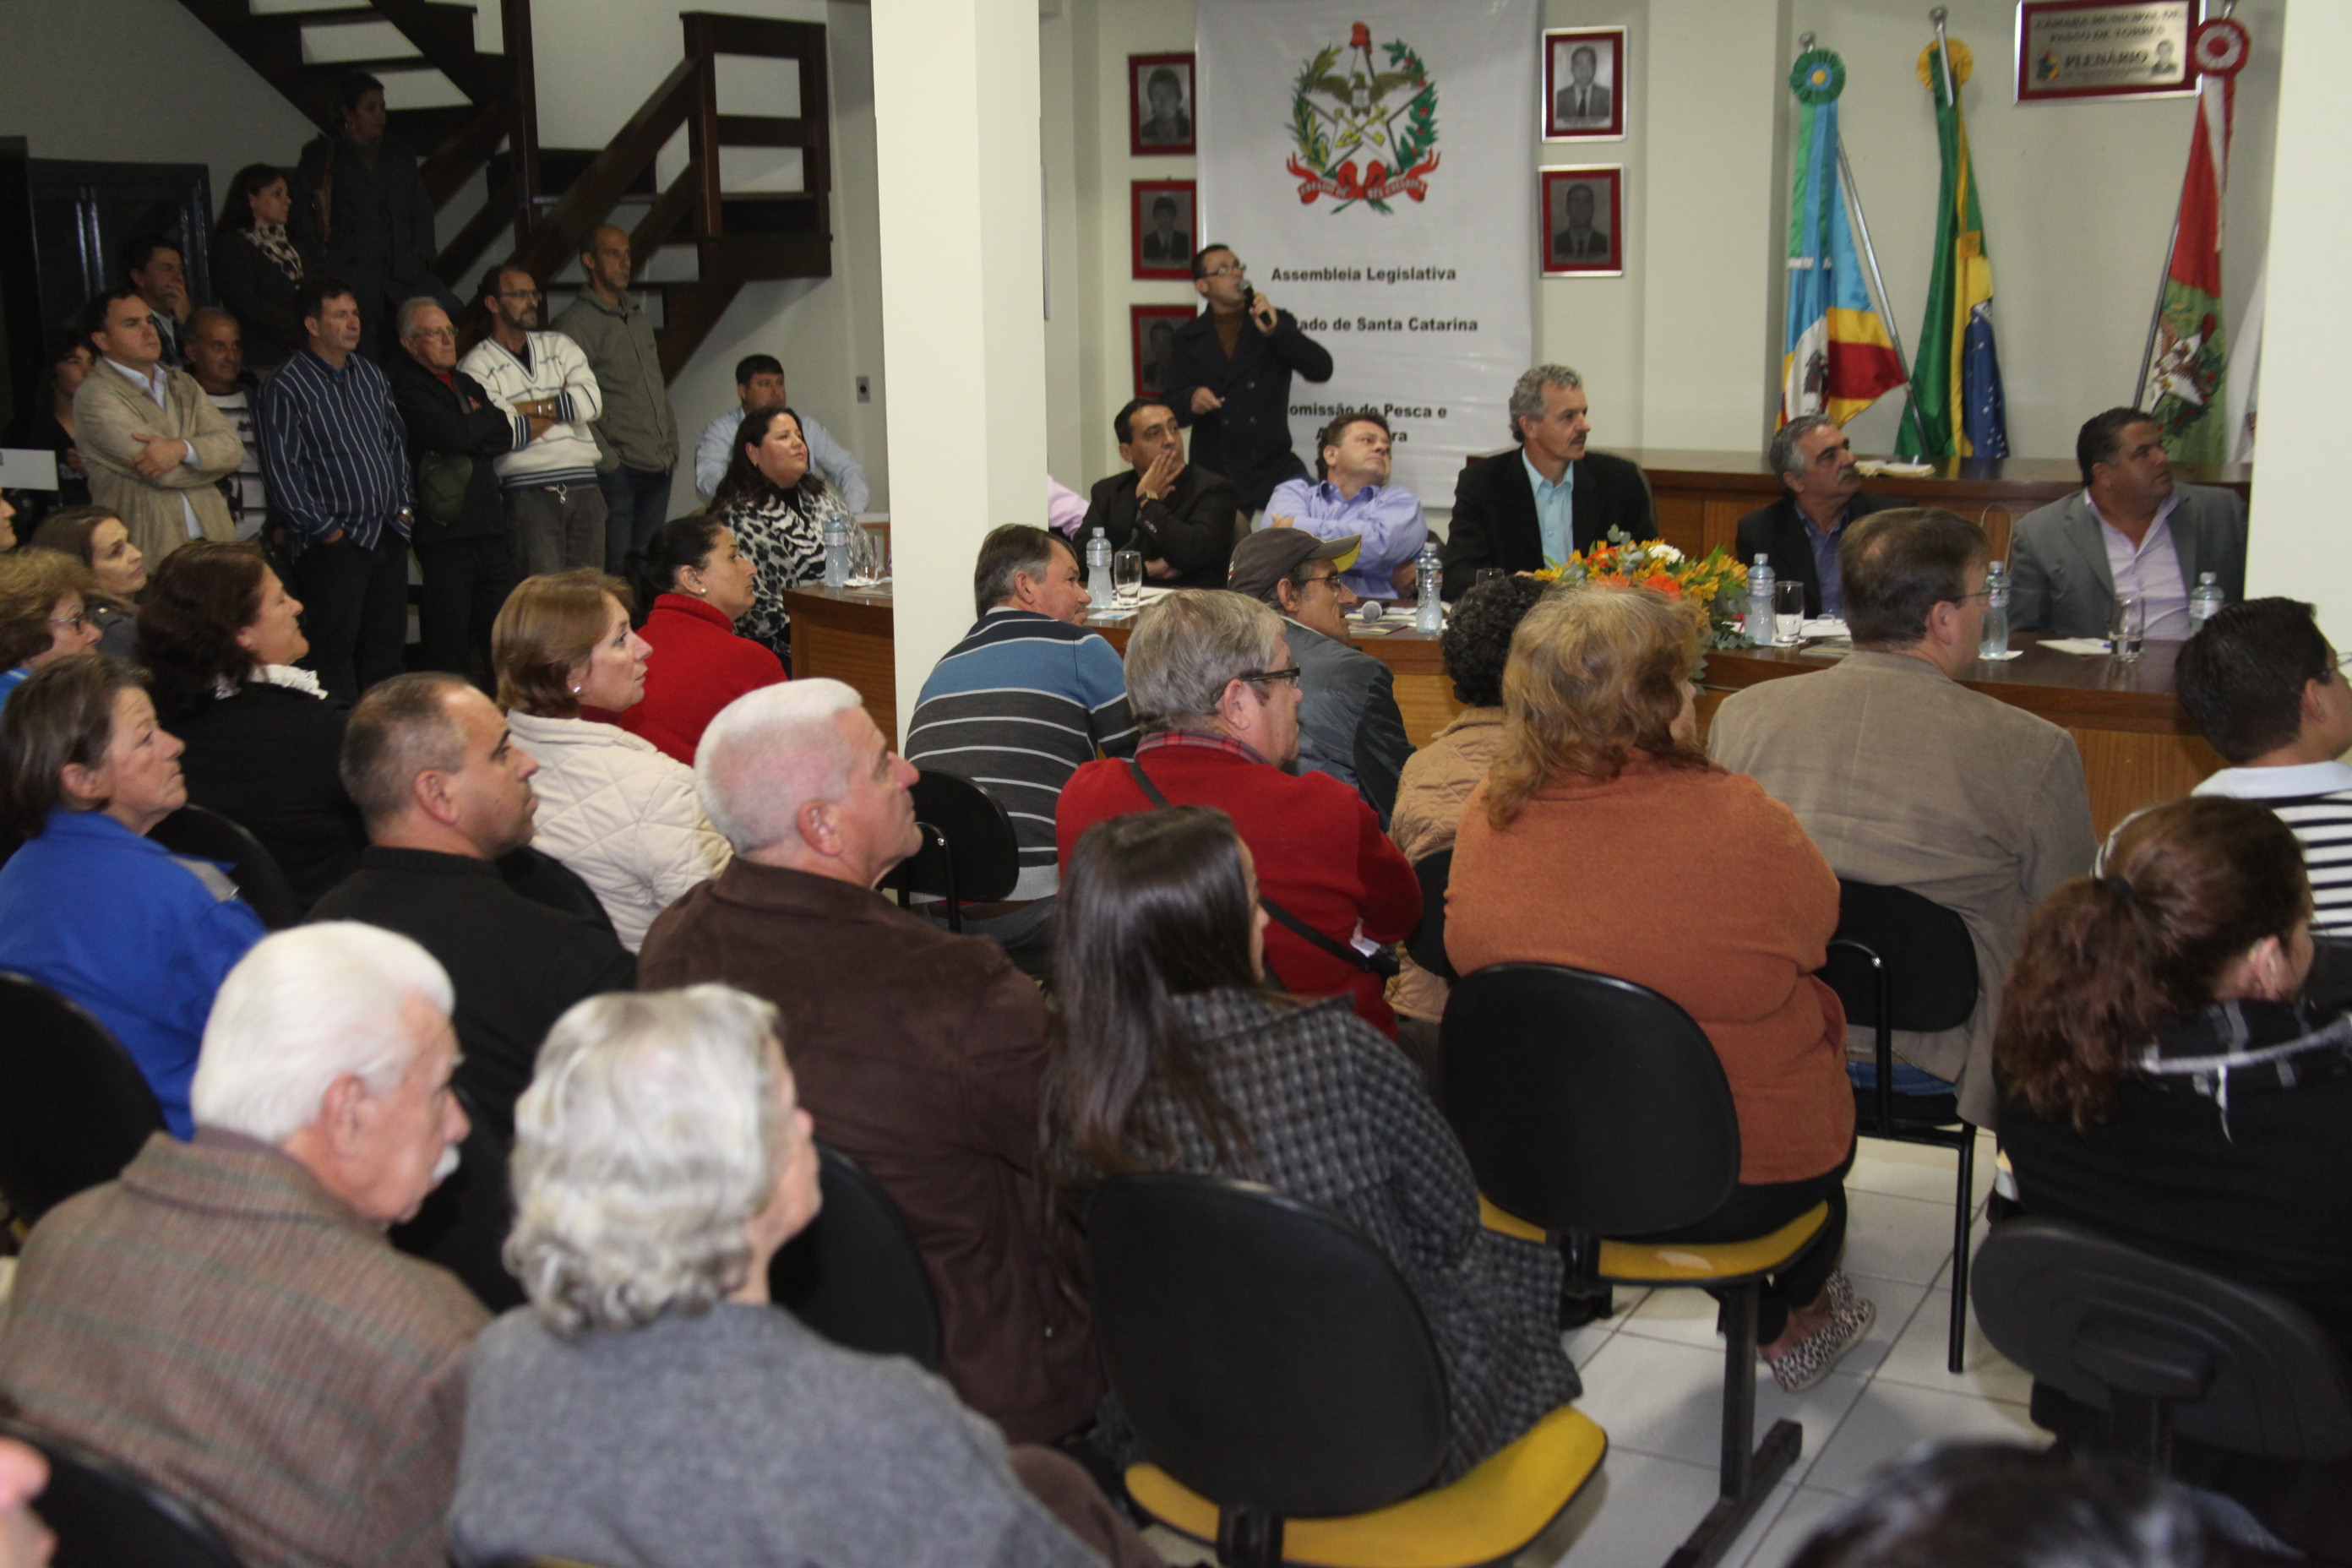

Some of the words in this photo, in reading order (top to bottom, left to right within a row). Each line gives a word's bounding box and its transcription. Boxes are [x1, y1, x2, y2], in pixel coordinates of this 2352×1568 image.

[2065, 49, 2149, 68] PLENÁRIO
[1271, 266, 1362, 281] Assembleia
[1366, 266, 1456, 285] Legislativa
[1332, 317, 1352, 331] de
[1356, 317, 1402, 332] Santa
[1408, 316, 1478, 332] Catarina
[1289, 401, 1353, 417] omissão
[1384, 403, 1432, 418] Pesca
[1438, 406, 1447, 418] e
